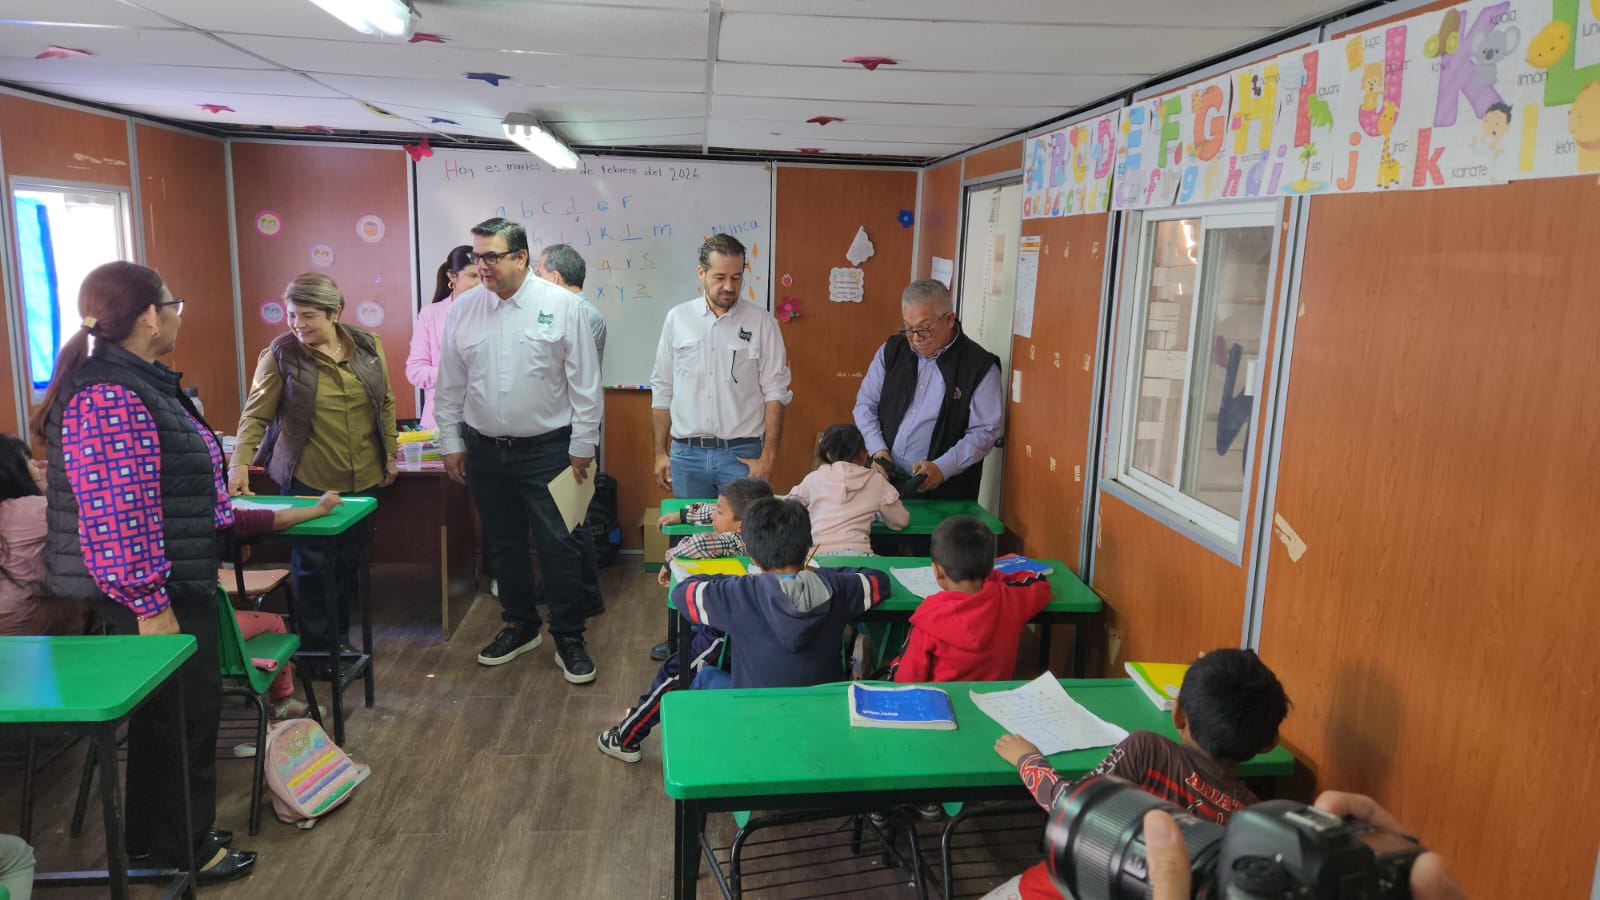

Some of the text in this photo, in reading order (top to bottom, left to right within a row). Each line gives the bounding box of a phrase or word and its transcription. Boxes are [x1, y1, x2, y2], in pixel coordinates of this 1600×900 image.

[1358, 25, 1408, 139] J
[1433, 1, 1511, 128] K
[1124, 106, 1145, 170] E
[1157, 95, 1182, 169] F
[1193, 85, 1225, 162] G
[1233, 63, 1279, 155] H
[444, 159, 475, 181] Hoy
[484, 164, 501, 173] es
[505, 161, 541, 172] martes
[579, 162, 594, 176] de
[644, 166, 663, 177] del
[669, 167, 700, 181] 2026
[1026, 139, 1044, 192] A
[1094, 118, 1115, 180] D
[1180, 166, 1198, 203] g
[1221, 155, 1242, 197] h
[1266, 143, 1288, 195] i
[1336, 131, 1362, 191] j
[521, 202, 534, 218] b
[566, 197, 578, 214] d
[653, 223, 672, 237] m
